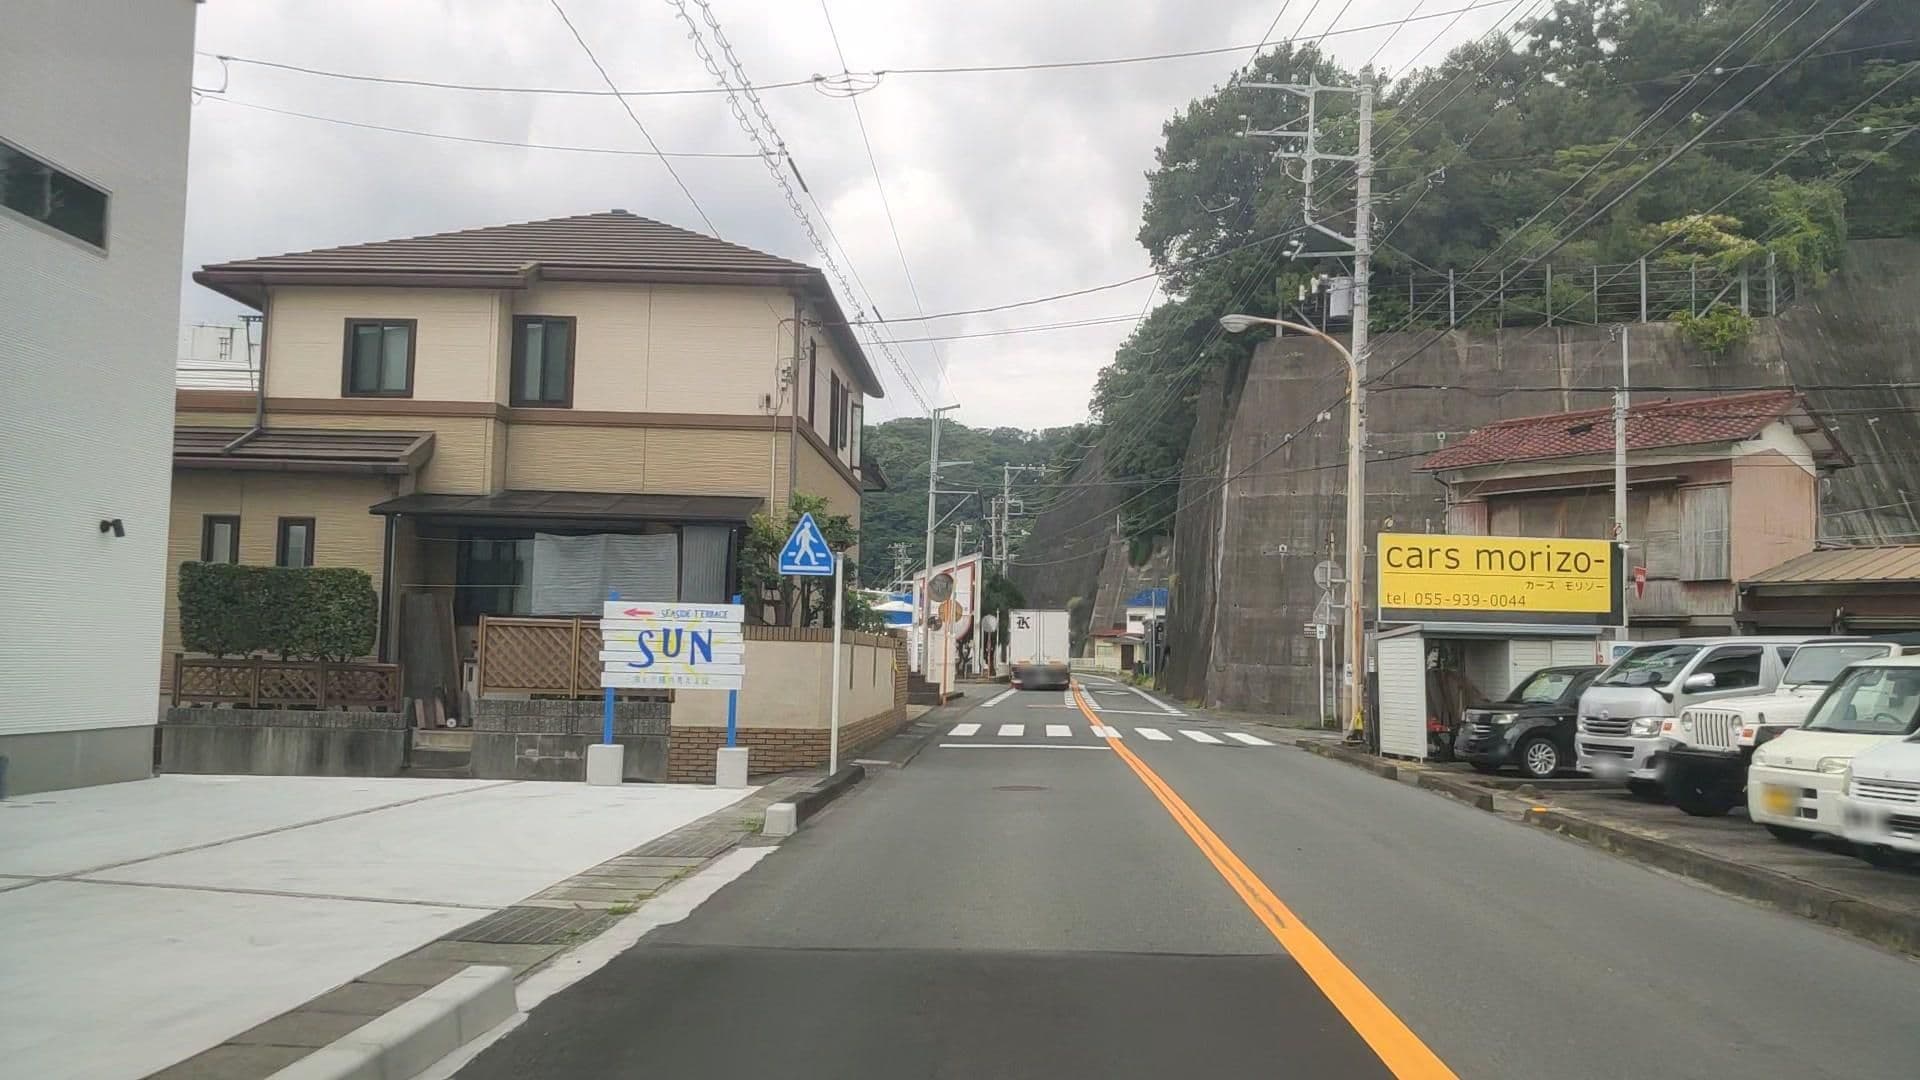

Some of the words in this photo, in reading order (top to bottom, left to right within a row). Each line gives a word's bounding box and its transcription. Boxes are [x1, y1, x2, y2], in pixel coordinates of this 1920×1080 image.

[1386, 545, 1460, 570] cars
[1475, 544, 1605, 573] morizo-
[1525, 581, 1555, 591] カース
[1386, 592, 1406, 605] tel
[1414, 592, 1527, 607] 055-939-0044
[661, 609, 692, 618] SEASIDE
[695, 610, 728, 618] TERRACE
[628, 627, 713, 668] SUN
